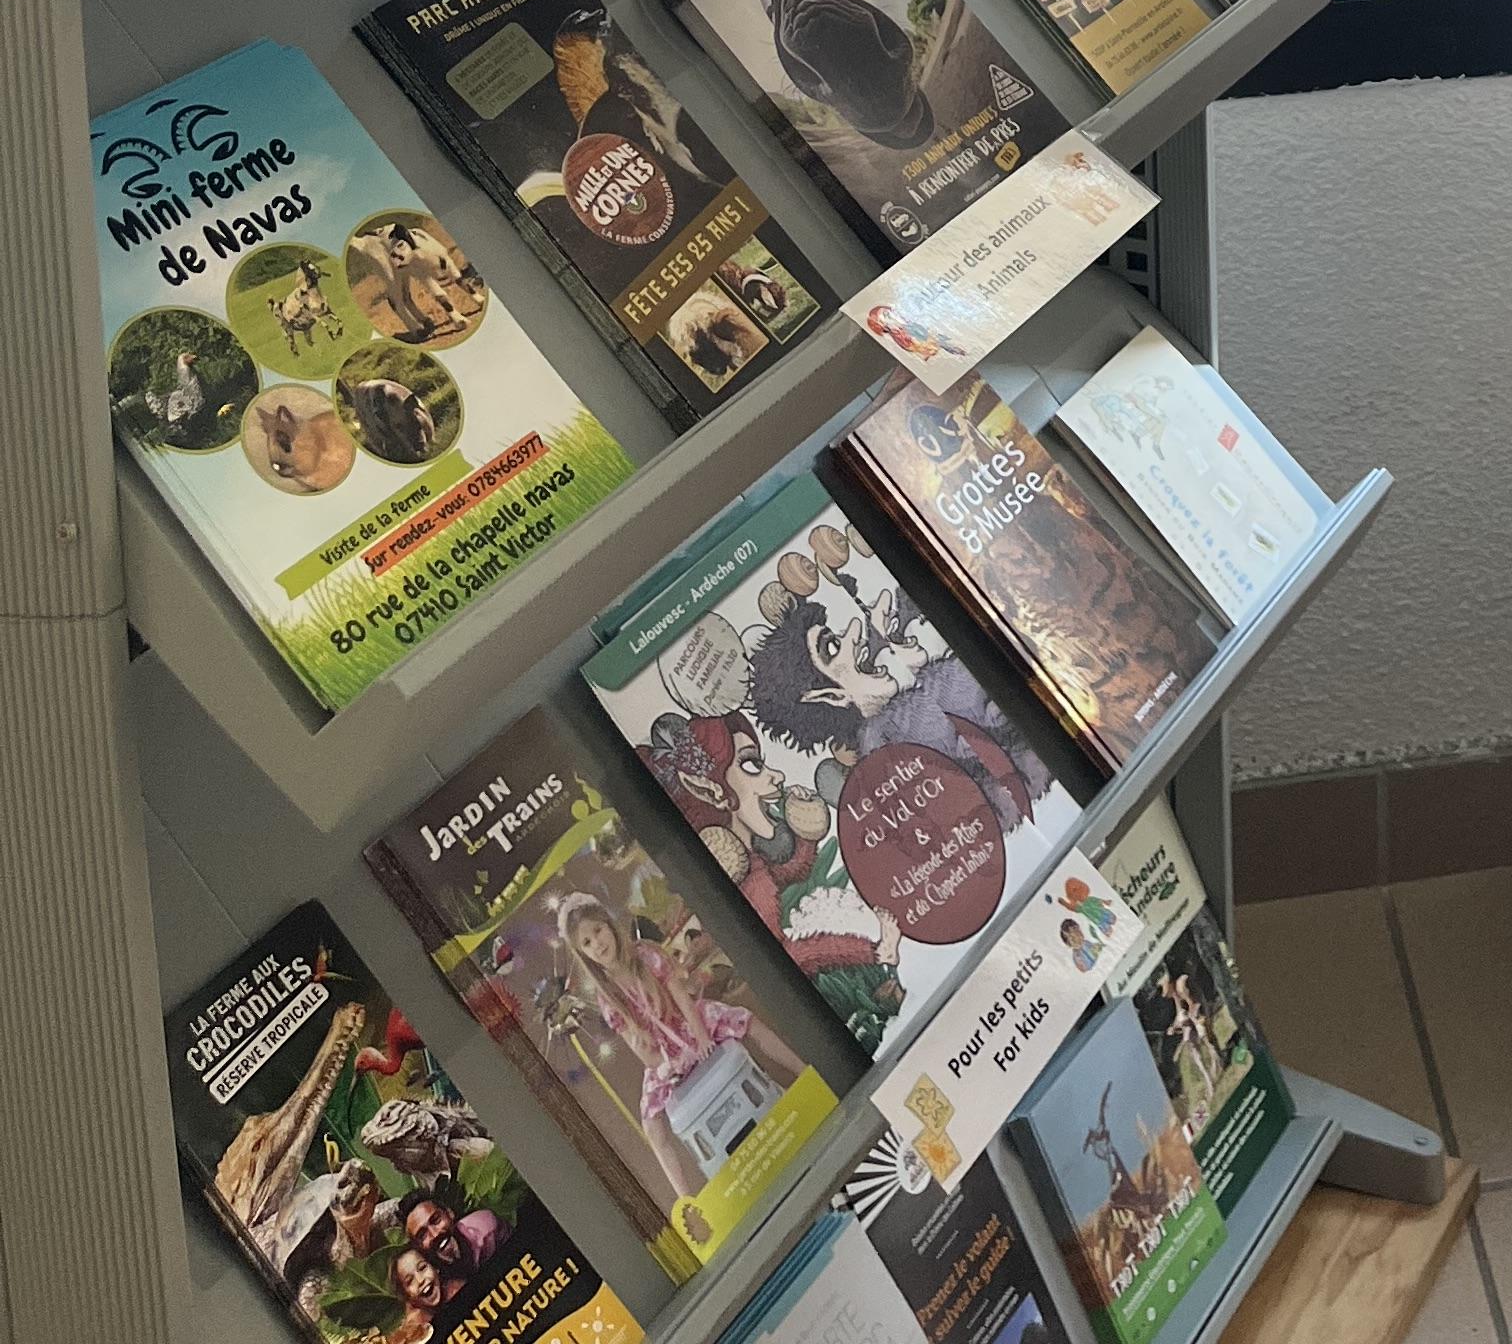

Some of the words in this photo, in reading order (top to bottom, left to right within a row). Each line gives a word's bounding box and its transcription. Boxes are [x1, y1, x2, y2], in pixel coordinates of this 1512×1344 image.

[107, 185, 192, 256] Mini
[190, 134, 297, 201] ferme
[575, 169, 603, 214] MILLE
[611, 141, 640, 171] UNE
[591, 156, 656, 227] CORNES
[902, 158, 927, 182] 1300
[924, 132, 963, 164] ANIMAUX
[918, 148, 981, 200] RENCONTRER
[158, 243, 206, 289] de
[210, 180, 314, 259] Navas
[624, 290, 666, 326] FÊTE
[662, 253, 692, 290] SES
[689, 236, 711, 264] 25
[708, 207, 743, 246] ANS
[963, 241, 992, 268] des
[988, 194, 1052, 250] animaux
[976, 248, 1038, 300] Animals
[364, 554, 387, 574] Sur
[390, 494, 470, 553] rendez-vous:
[467, 434, 544, 498] 0784663977
[935, 439, 1027, 529] Grottes
[957, 522, 983, 556] &
[975, 466, 1047, 542] Musée
[320, 534, 359, 565] Visite
[360, 522, 378, 540] de
[376, 513, 393, 529] la
[391, 484, 431, 517] ferme
[330, 619, 366, 654] 80
[366, 594, 404, 628] rue
[403, 572, 430, 600] de
[427, 559, 453, 584] la
[451, 500, 527, 564] chapelle
[524, 463, 575, 508] navas
[394, 588, 459, 645] 07410
[455, 552, 509, 598] Saint
[499, 513, 557, 560] Victor
[629, 601, 688, 656] Lalouvesc
[689, 554, 736, 604] Ardèche
[733, 537, 760, 568] (07)
[673, 624, 706, 676] PARCOURS
[686, 638, 714, 682] LUDIQUE
[696, 649, 725, 691] FAMILIAL
[847, 796, 875, 823] Le
[874, 755, 925, 804] sentier
[864, 825, 888, 849] du
[881, 799, 915, 830] Val
[914, 775, 945, 809] d'Or
[914, 827, 932, 847] &
[940, 837, 960, 860] des
[186, 956, 313, 1072] CROCODILES
[190, 1015, 211, 1037] LA
[206, 977, 254, 1022] FERME
[251, 953, 282, 986] AUX
[947, 1029, 985, 1079] Pour
[979, 1001, 1006, 1034] les
[1002, 949, 1044, 1010] petits
[216, 1044, 266, 1098] RÉSERVE
[261, 986, 325, 1050] TROPICALE
[993, 1035, 1021, 1072] For
[1014, 998, 1050, 1040] kids
[501, 1265, 573, 1344] NATURE
